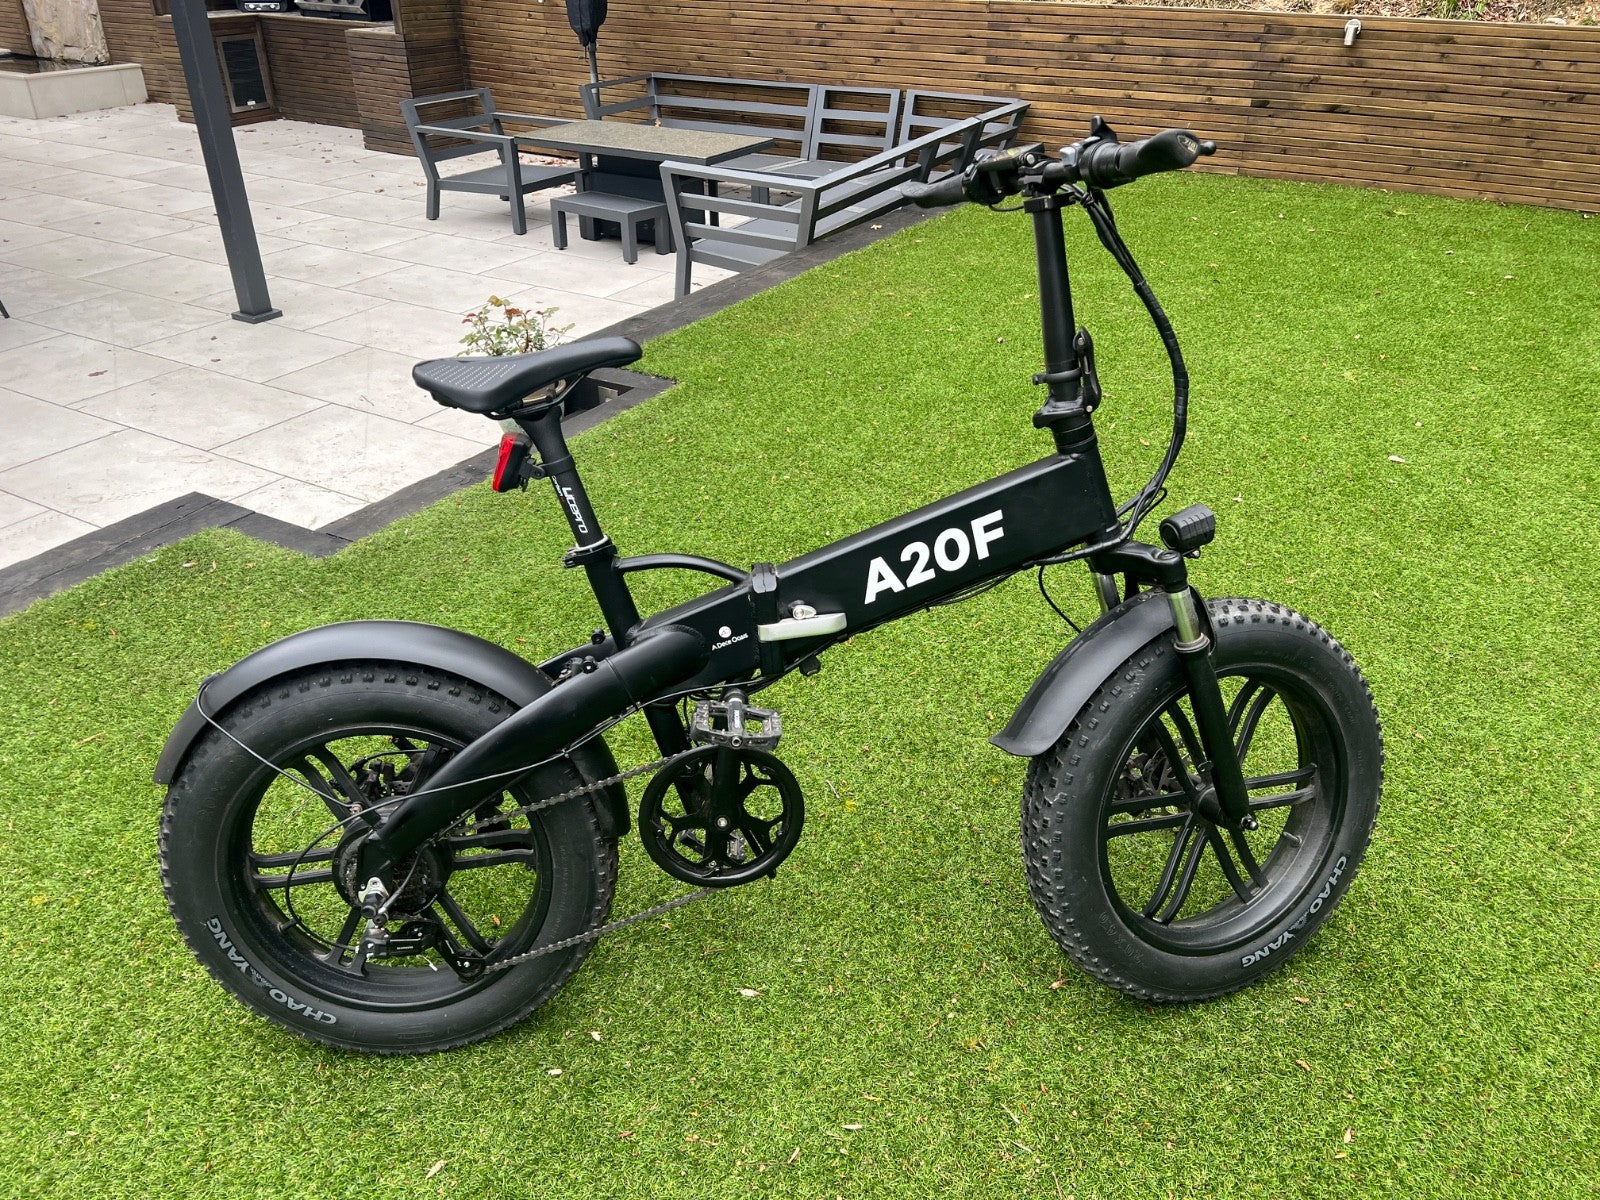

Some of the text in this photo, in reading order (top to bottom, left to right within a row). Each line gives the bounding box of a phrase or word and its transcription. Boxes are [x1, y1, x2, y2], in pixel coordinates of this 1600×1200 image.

[864, 509, 1005, 605] A20F
[1241, 856, 1347, 968] CHAO YANG
[206, 917, 337, 1024] CHAO YANG
